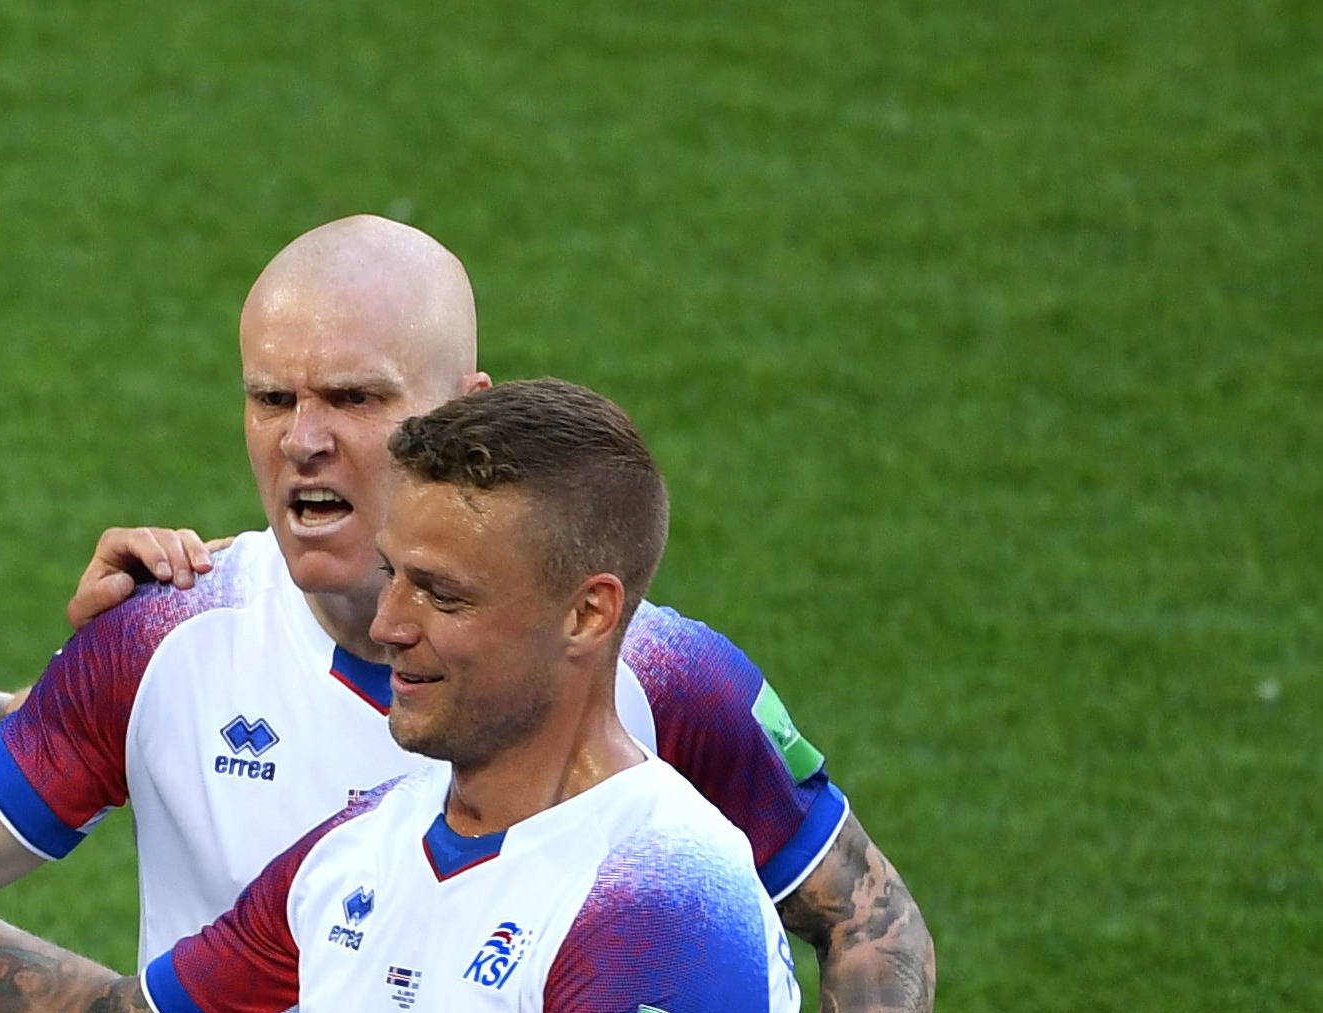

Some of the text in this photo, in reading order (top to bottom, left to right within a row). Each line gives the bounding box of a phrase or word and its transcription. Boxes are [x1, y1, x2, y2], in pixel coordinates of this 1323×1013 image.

[214, 755, 276, 781] errea
[328, 924, 364, 951] errea
[462, 950, 519, 990] KSI
